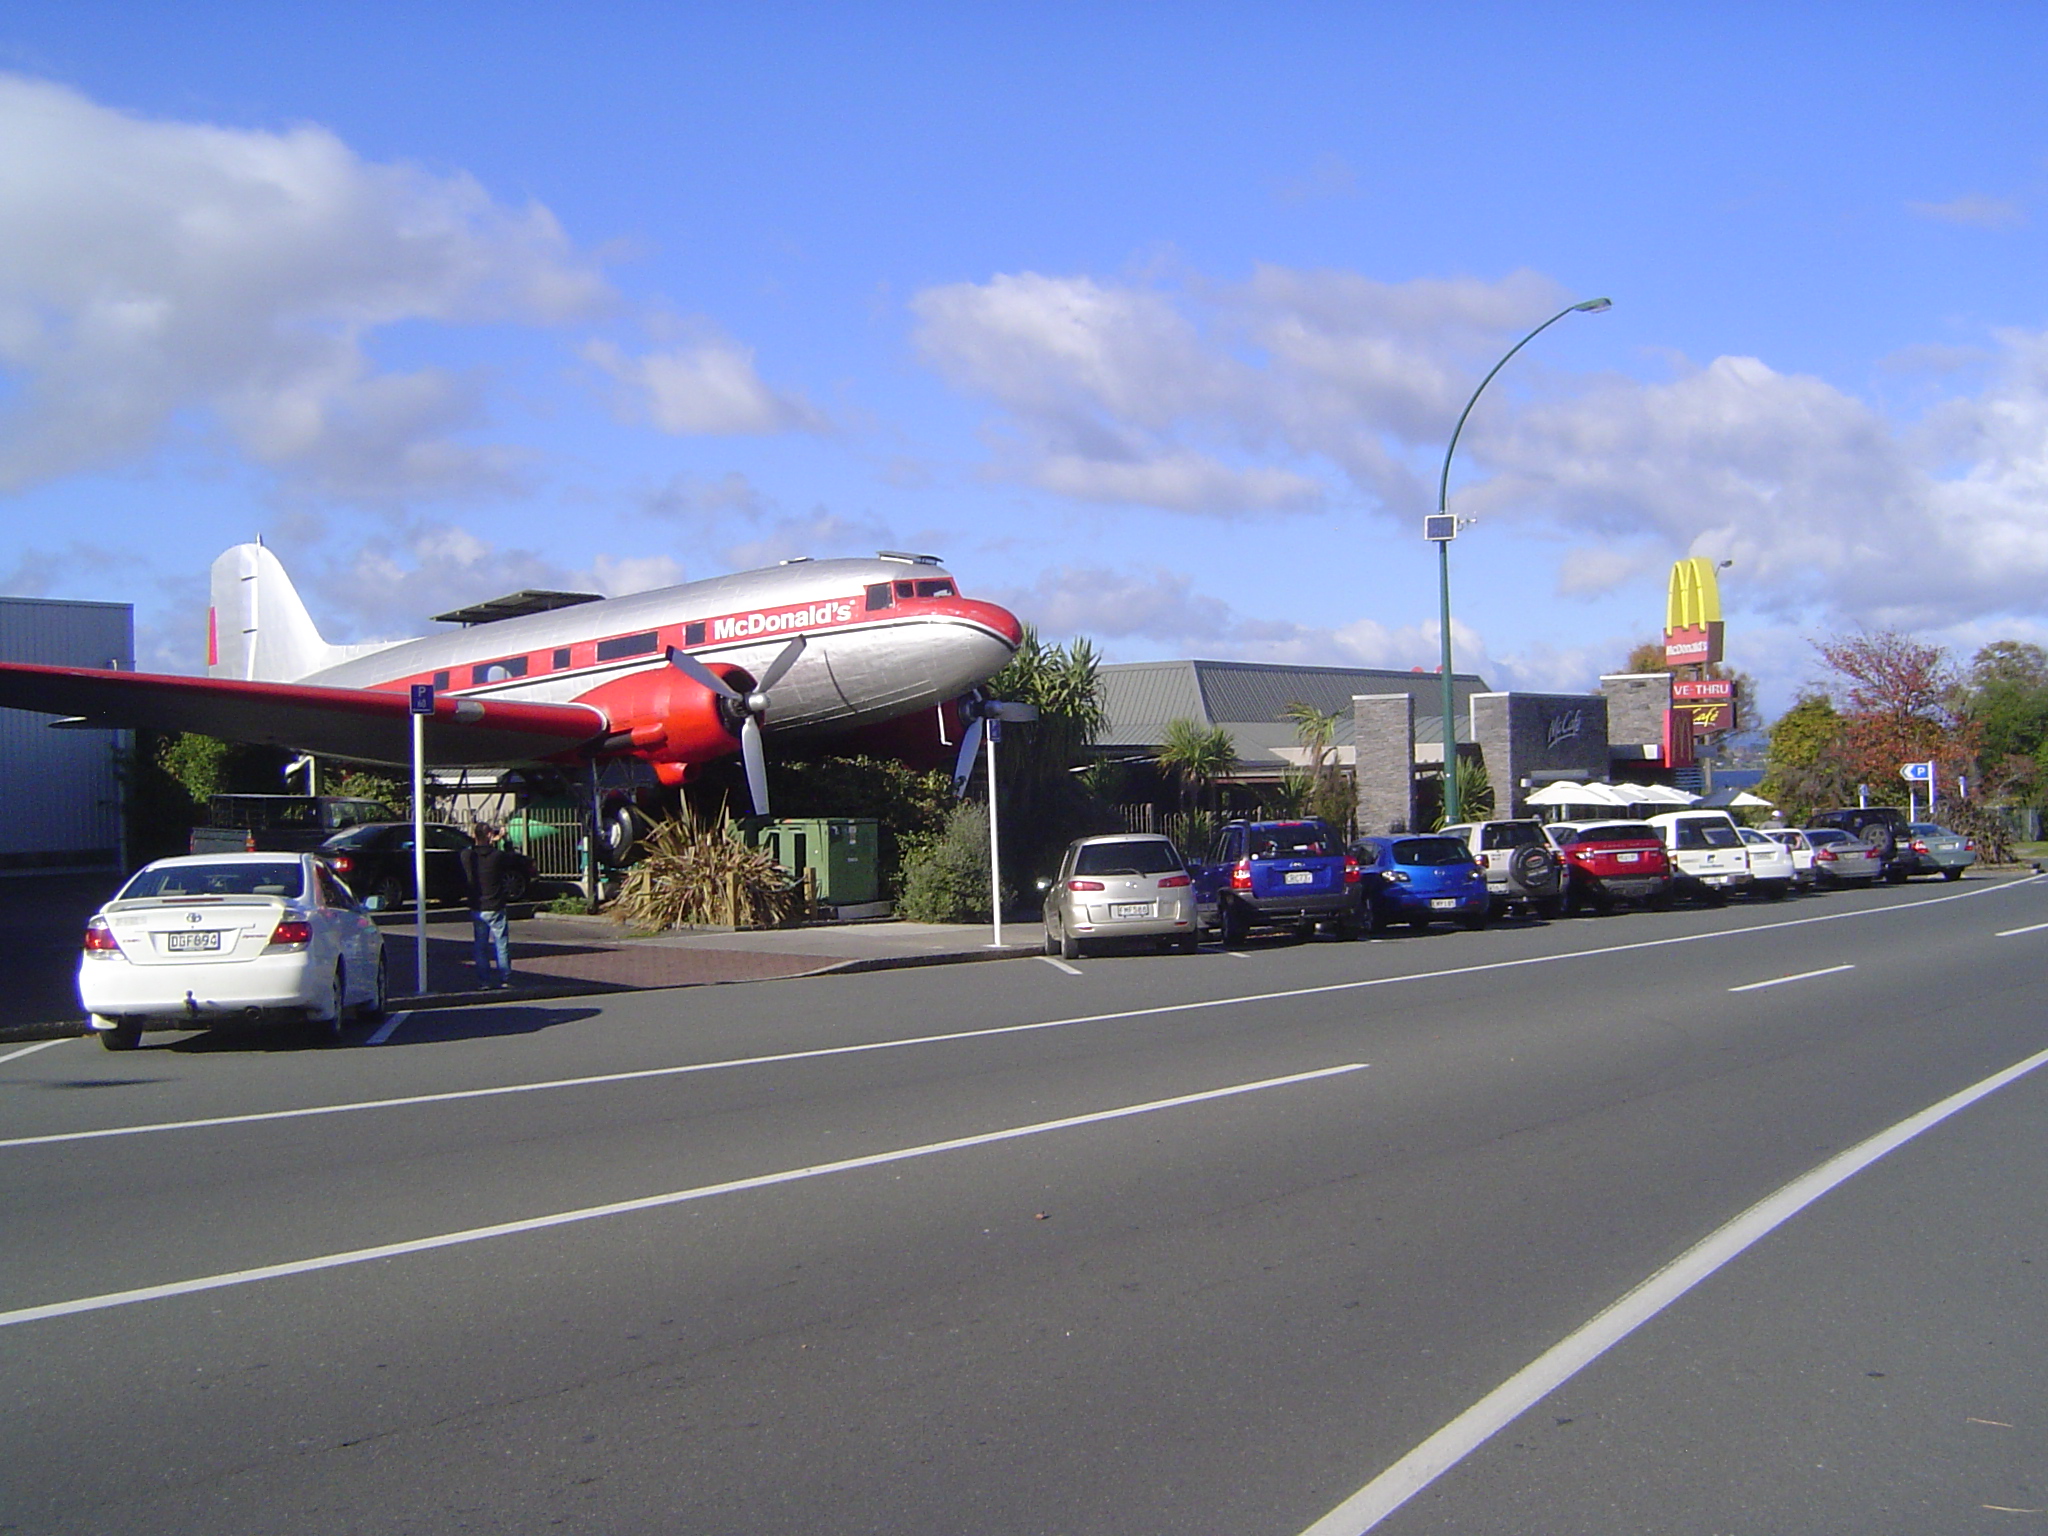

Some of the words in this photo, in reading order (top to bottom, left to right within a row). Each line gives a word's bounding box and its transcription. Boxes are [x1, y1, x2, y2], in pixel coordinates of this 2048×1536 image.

[714, 602, 852, 641] McDonald's
[1673, 683, 1729, 696] VE-THRU
[1917, 767, 1925, 776] P
